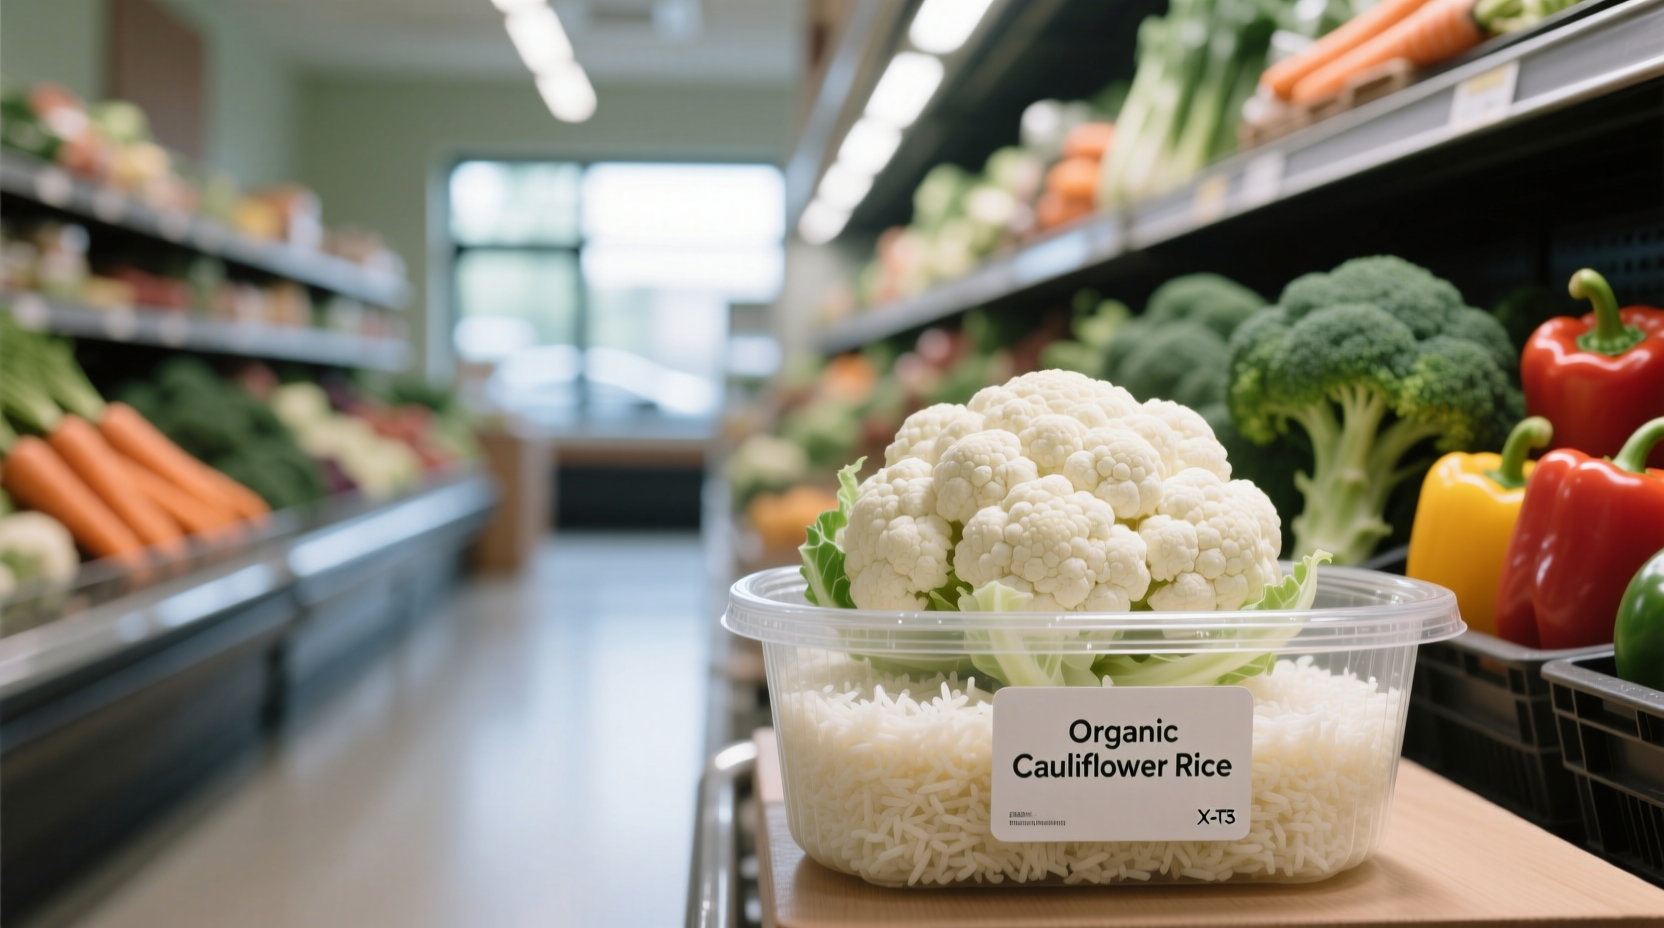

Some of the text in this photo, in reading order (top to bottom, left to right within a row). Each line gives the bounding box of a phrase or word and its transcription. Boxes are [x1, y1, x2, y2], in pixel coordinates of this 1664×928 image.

[1069, 718, 1179, 750] Organic
[1012, 752, 1232, 778] Cauliflower Rice
[1197, 809, 1235, 825] X-T3
